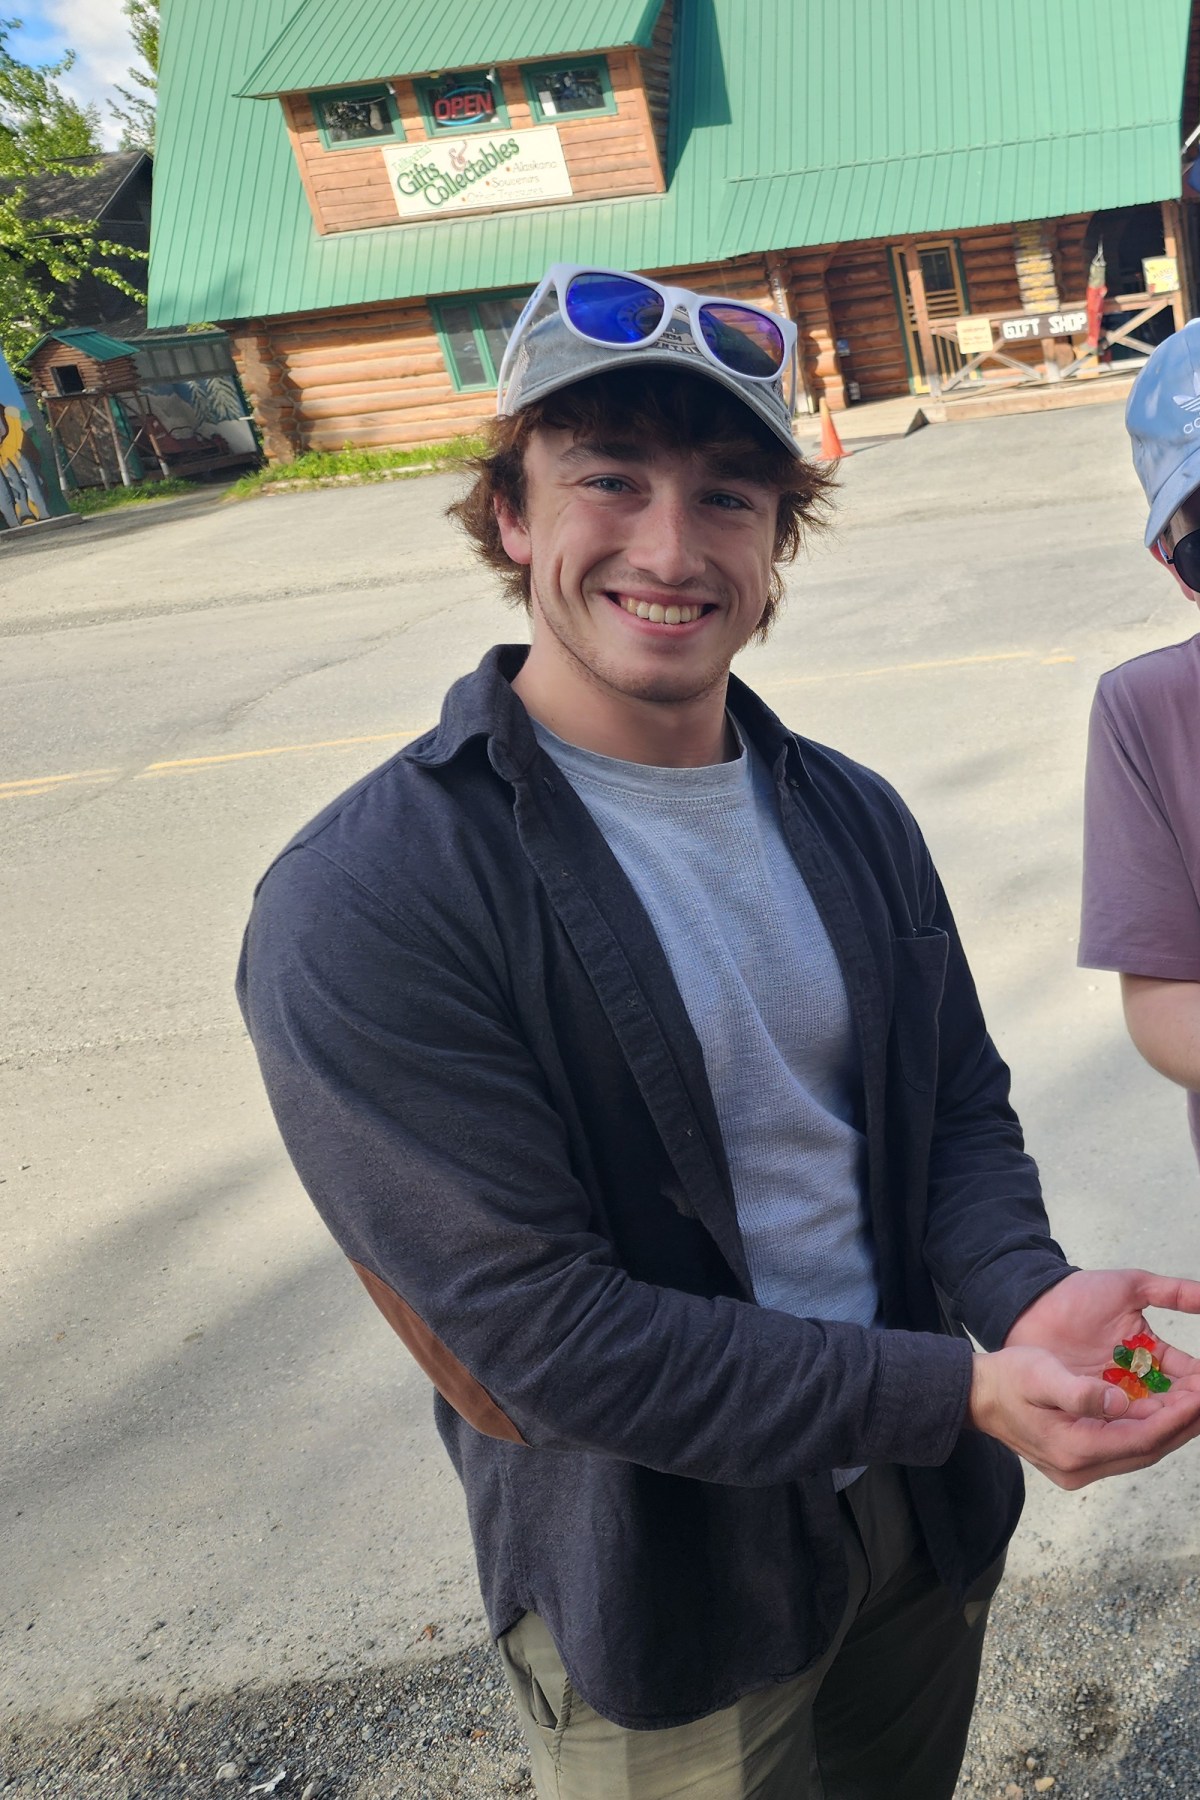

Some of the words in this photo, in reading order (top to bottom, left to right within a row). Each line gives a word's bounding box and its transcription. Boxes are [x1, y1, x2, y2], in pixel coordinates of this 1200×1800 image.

[434, 92, 493, 120] OPEN
[397, 163, 440, 196] Gifts
[424, 137, 520, 207] Collectables
[1002, 318, 1040, 339] GIFT
[1047, 312, 1088, 334] SHOP
